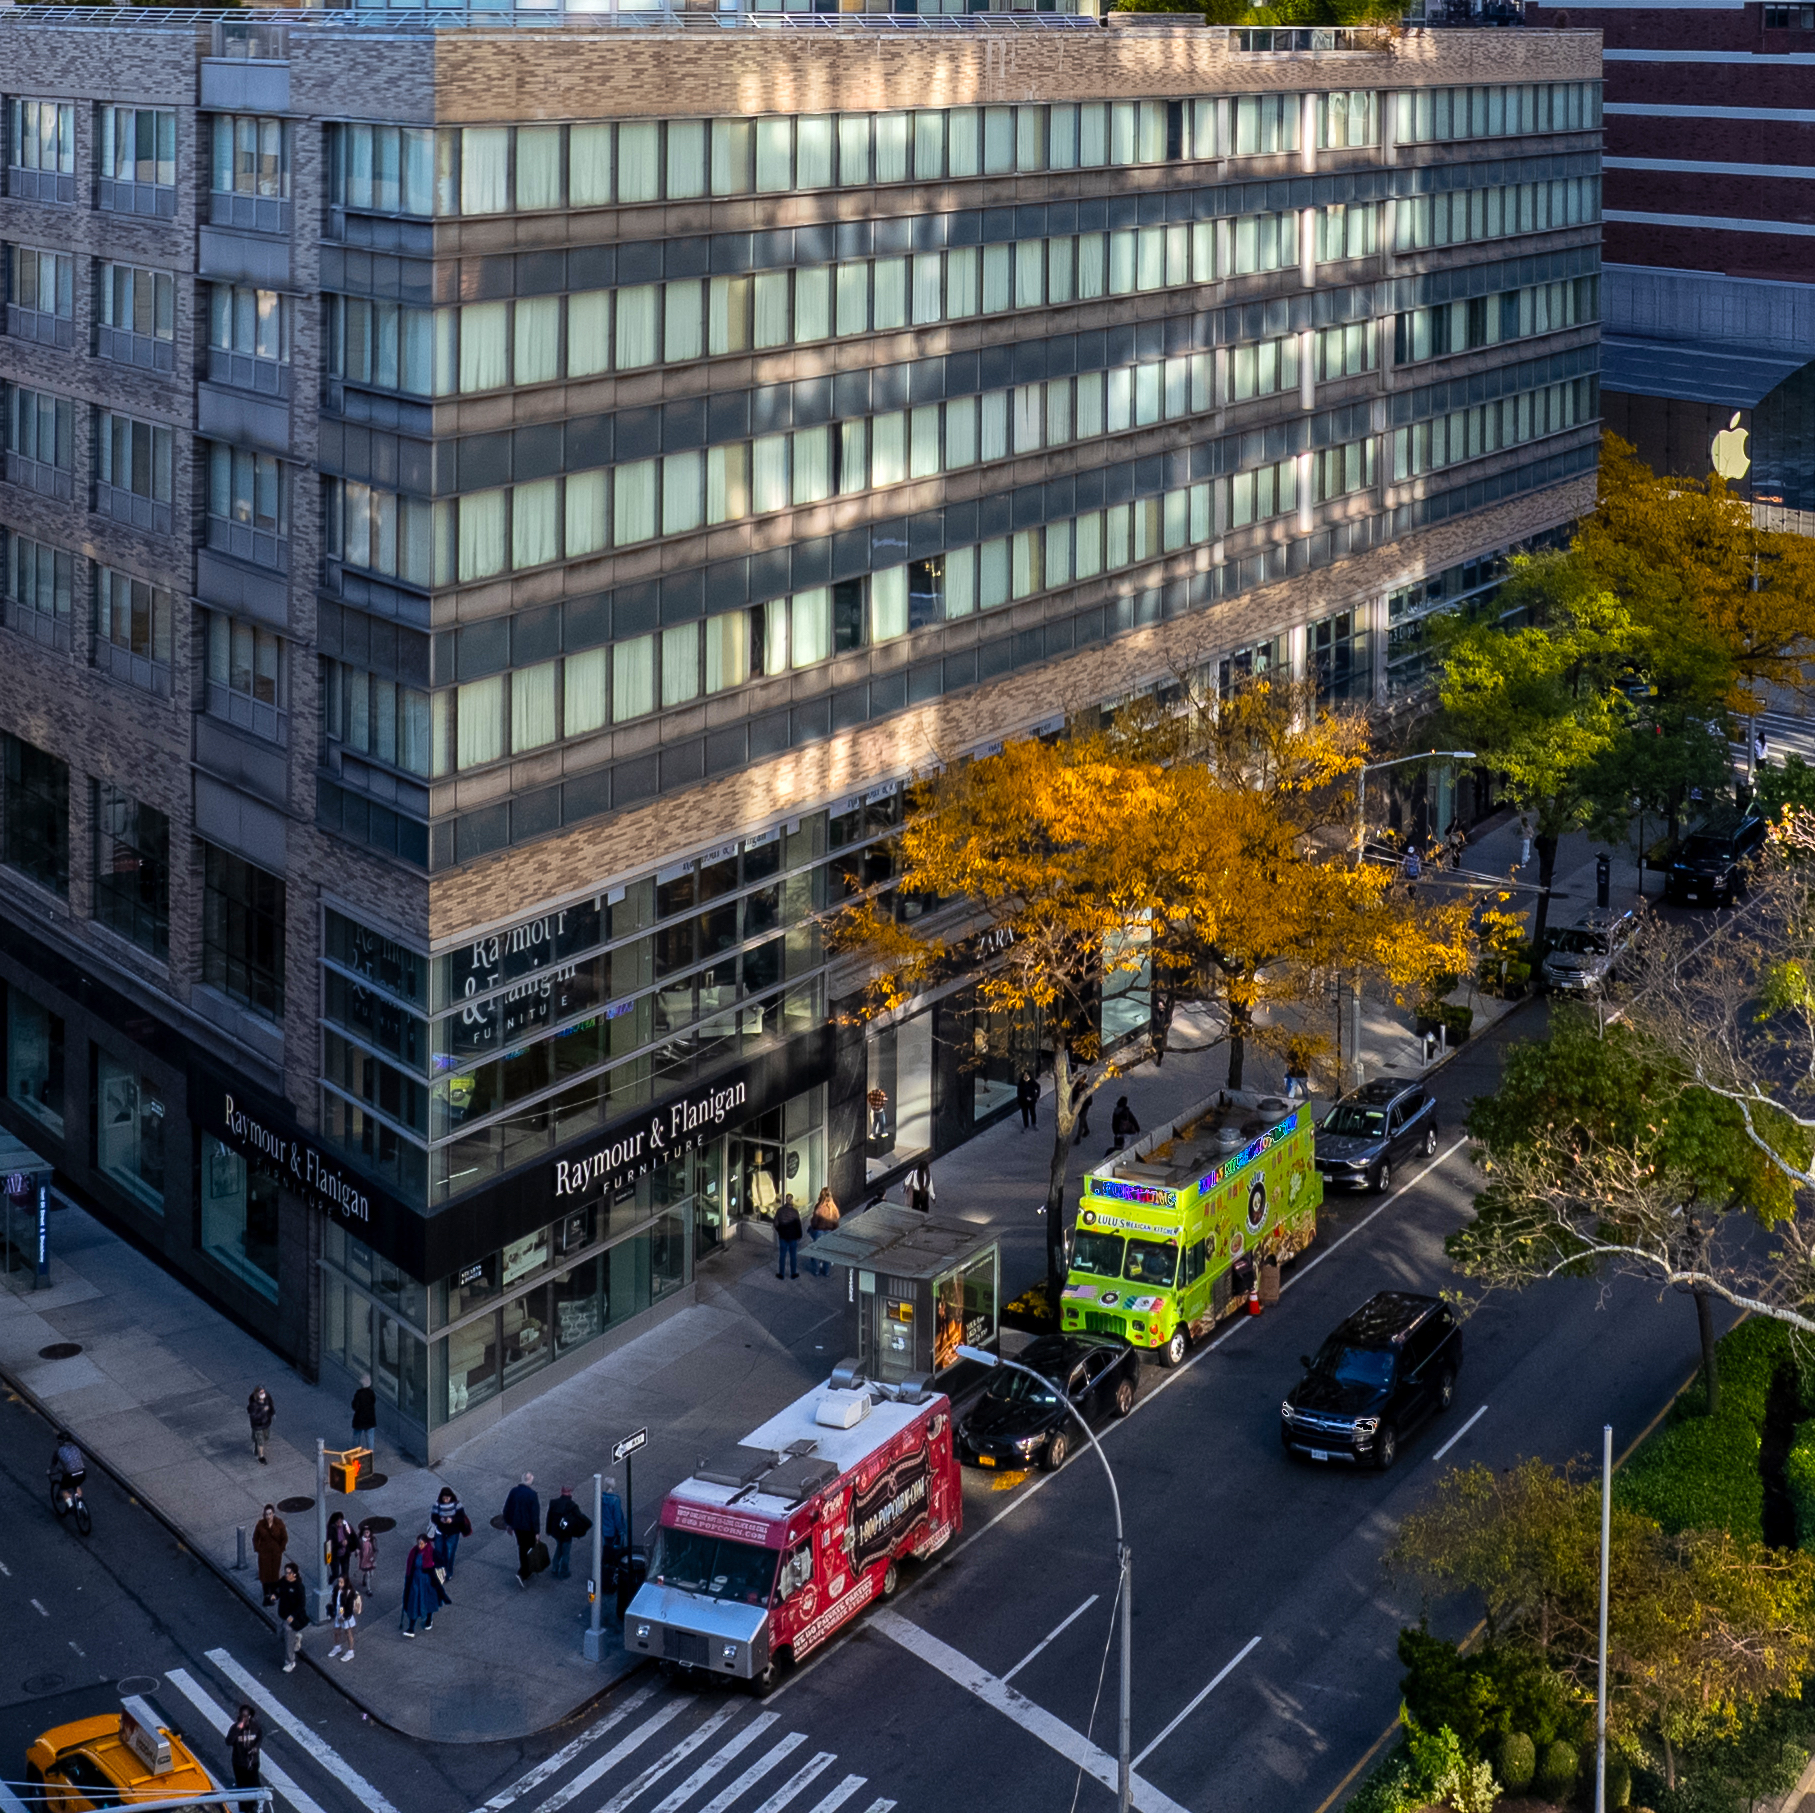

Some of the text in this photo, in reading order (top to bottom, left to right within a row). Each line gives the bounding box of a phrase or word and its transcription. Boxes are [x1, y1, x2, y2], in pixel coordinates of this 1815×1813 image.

[472, 910, 567, 969] Ramor
[473, 995, 567, 1044] FUNITUE
[225, 1094, 368, 1222] Raymour & Flanigan
[556, 1082, 746, 1197] Raymour & Flanigan
[603, 1134, 703, 1195] FURNITURE
[699, 1520, 766, 1540] POPCORN.COM
